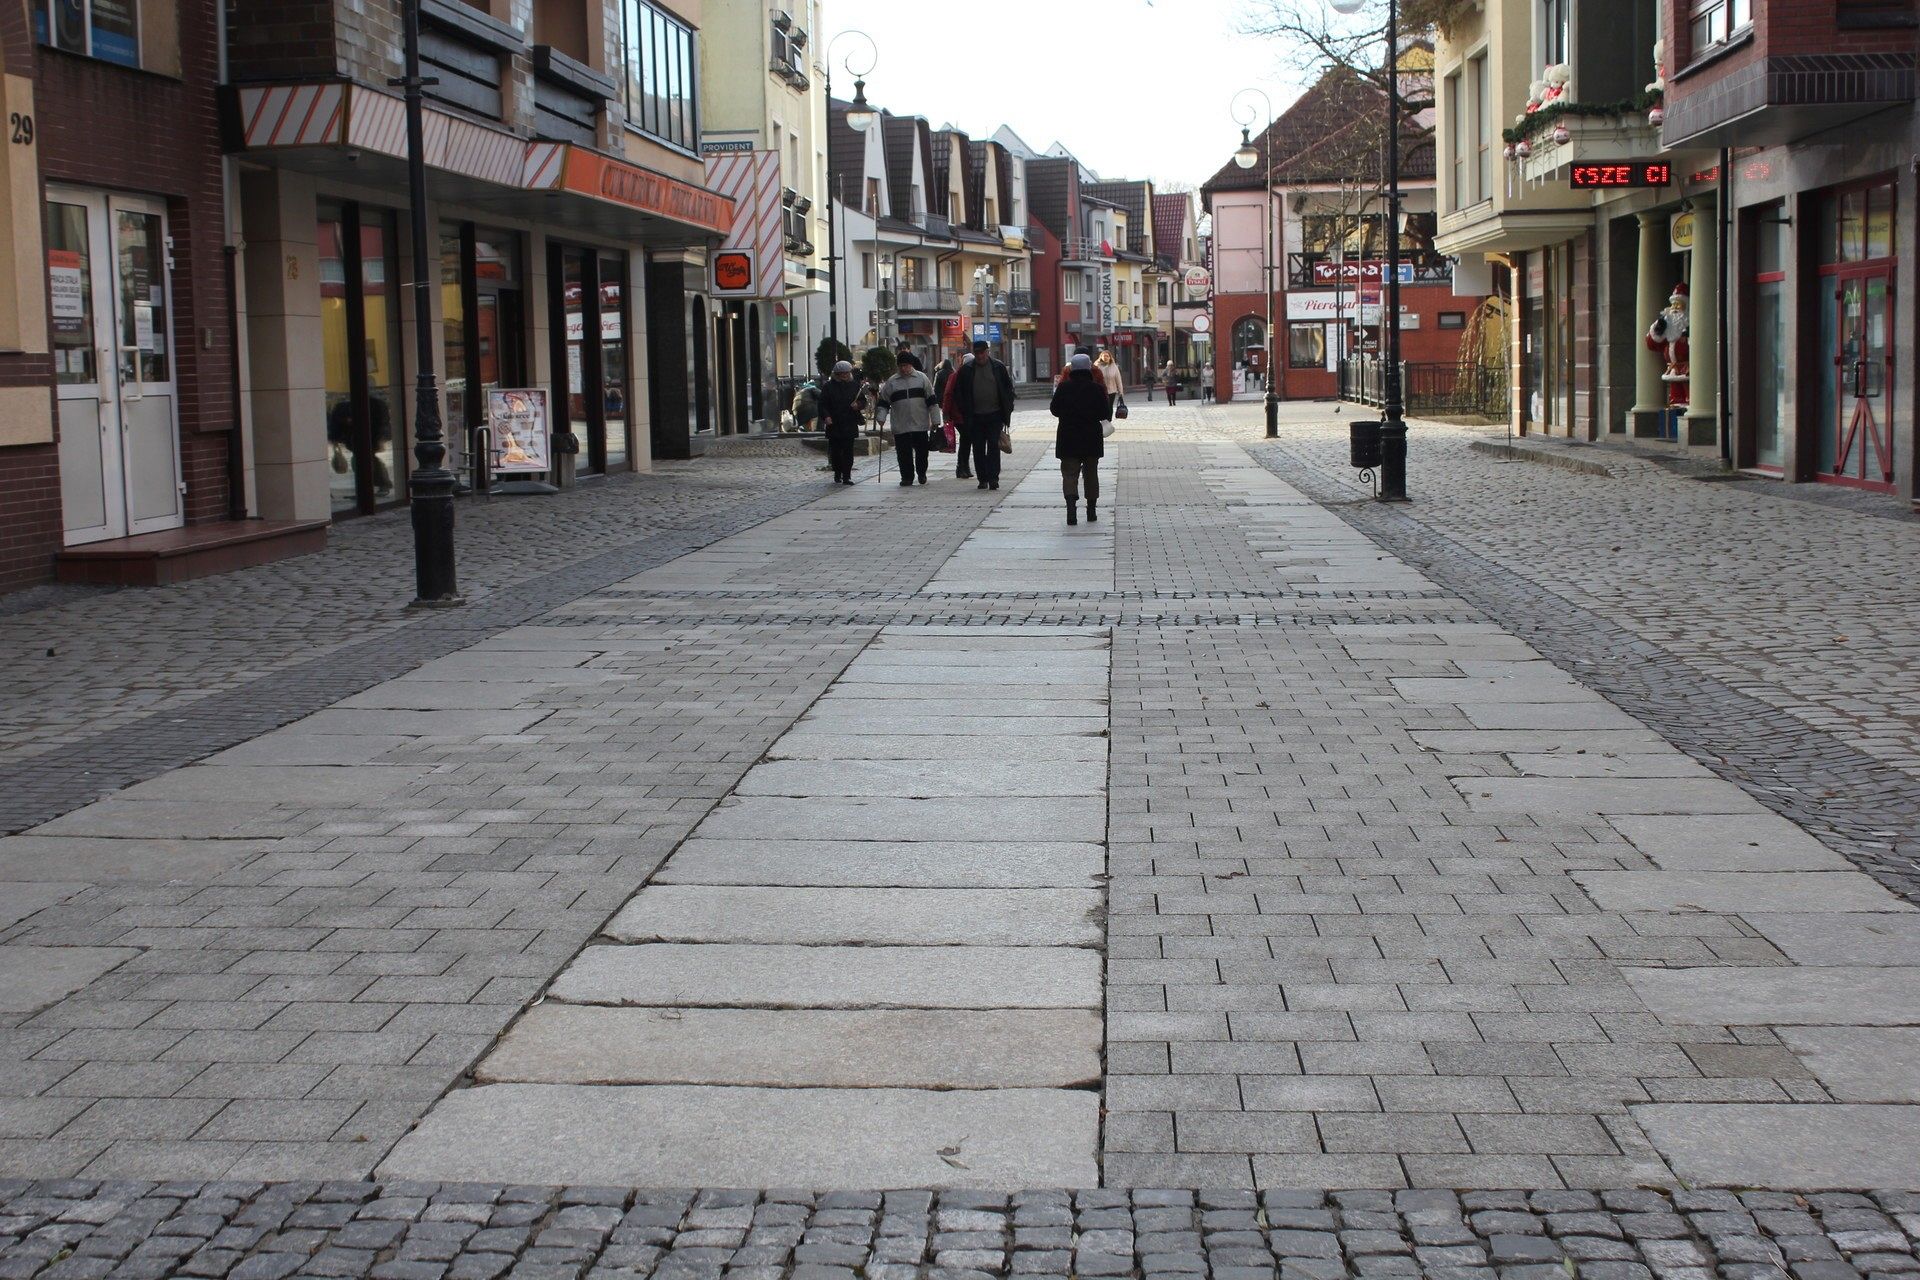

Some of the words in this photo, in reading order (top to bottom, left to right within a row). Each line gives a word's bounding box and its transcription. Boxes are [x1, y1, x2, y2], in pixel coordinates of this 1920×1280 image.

[11, 112, 34, 145] 29
[703, 142, 751, 151] PROVIDENT
[1102, 274, 1112, 329] DROGERIA
